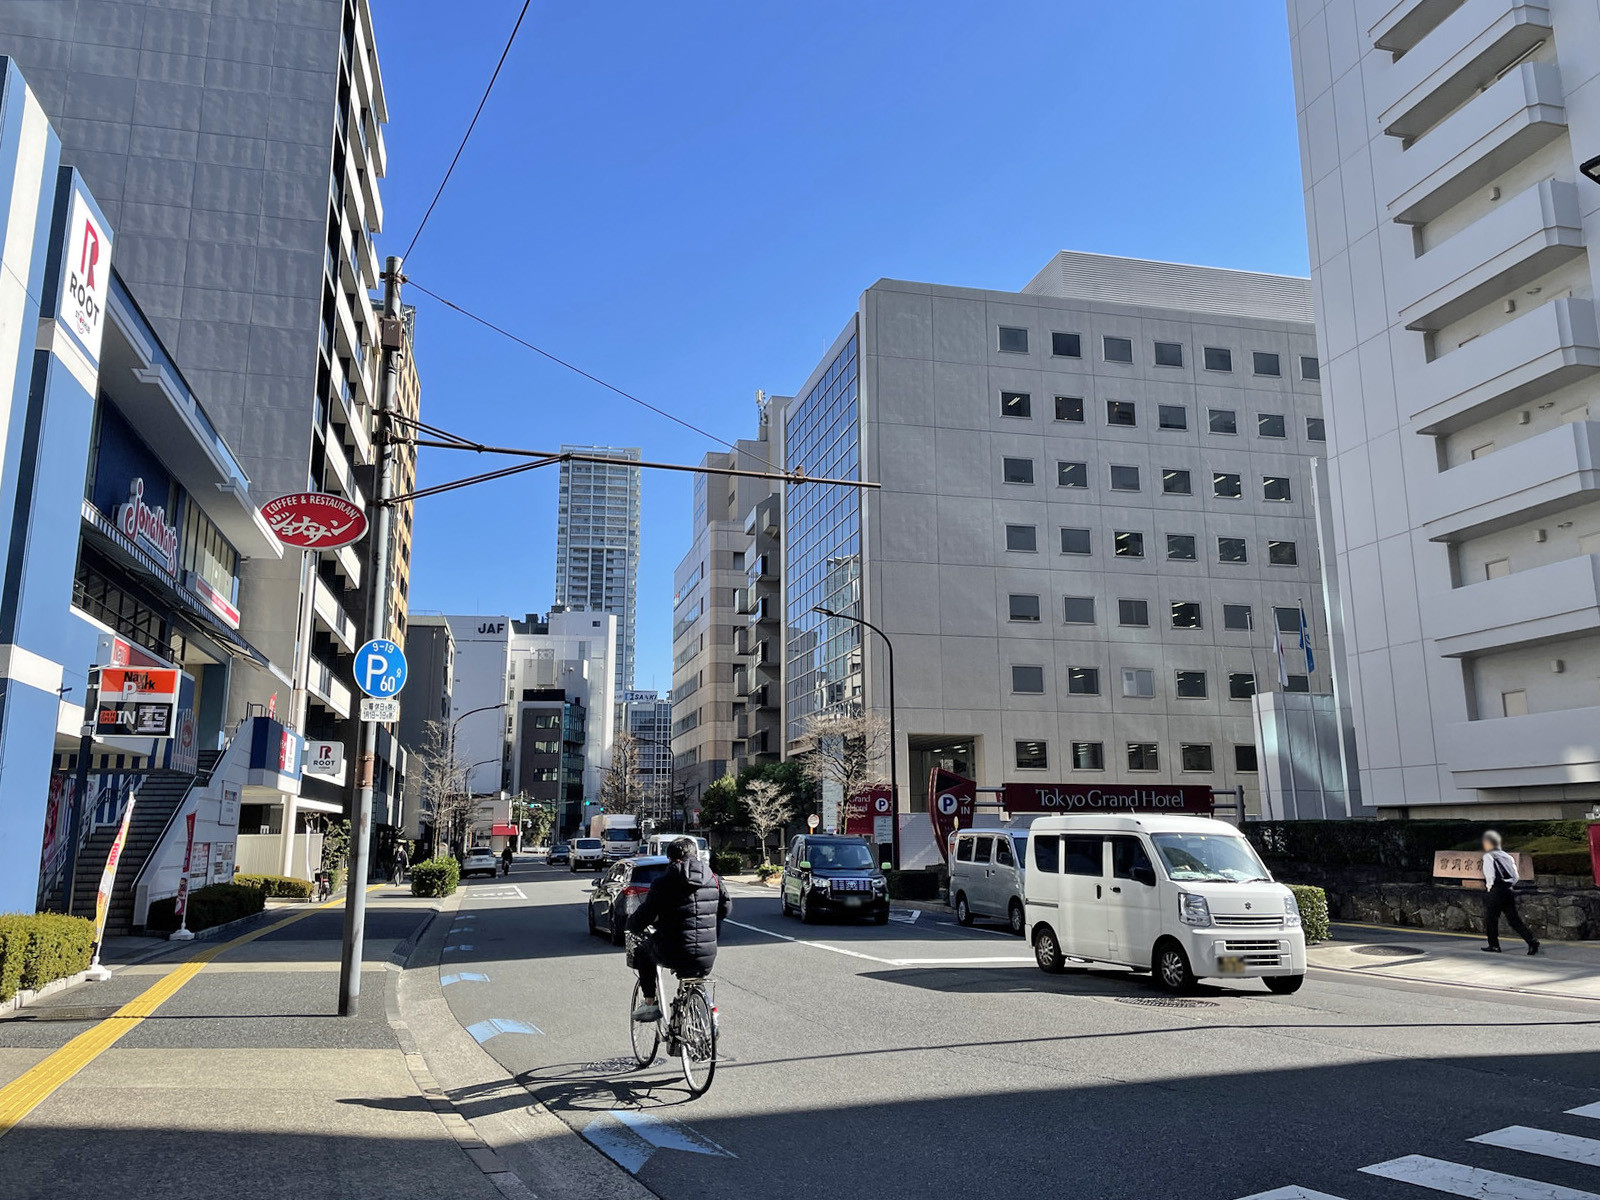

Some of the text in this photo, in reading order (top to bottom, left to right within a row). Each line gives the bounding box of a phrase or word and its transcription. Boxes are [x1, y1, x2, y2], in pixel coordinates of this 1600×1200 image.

[69, 271, 100, 327] ROOT
[266, 495, 361, 520] COFFEE & RESTAURANT
[269, 511, 355, 546] ジョナサン
[477, 622, 505, 634] JAF
[372, 642, 395, 654] 9-19
[365, 654, 389, 691] P
[380, 675, 396, 692] 60
[116, 711, 136, 724] IN
[878, 799, 886, 810] P
[942, 797, 954, 811] P
[1035, 788, 1185, 810] Tokyo Grand Hotel
[961, 806, 971, 814] IN
